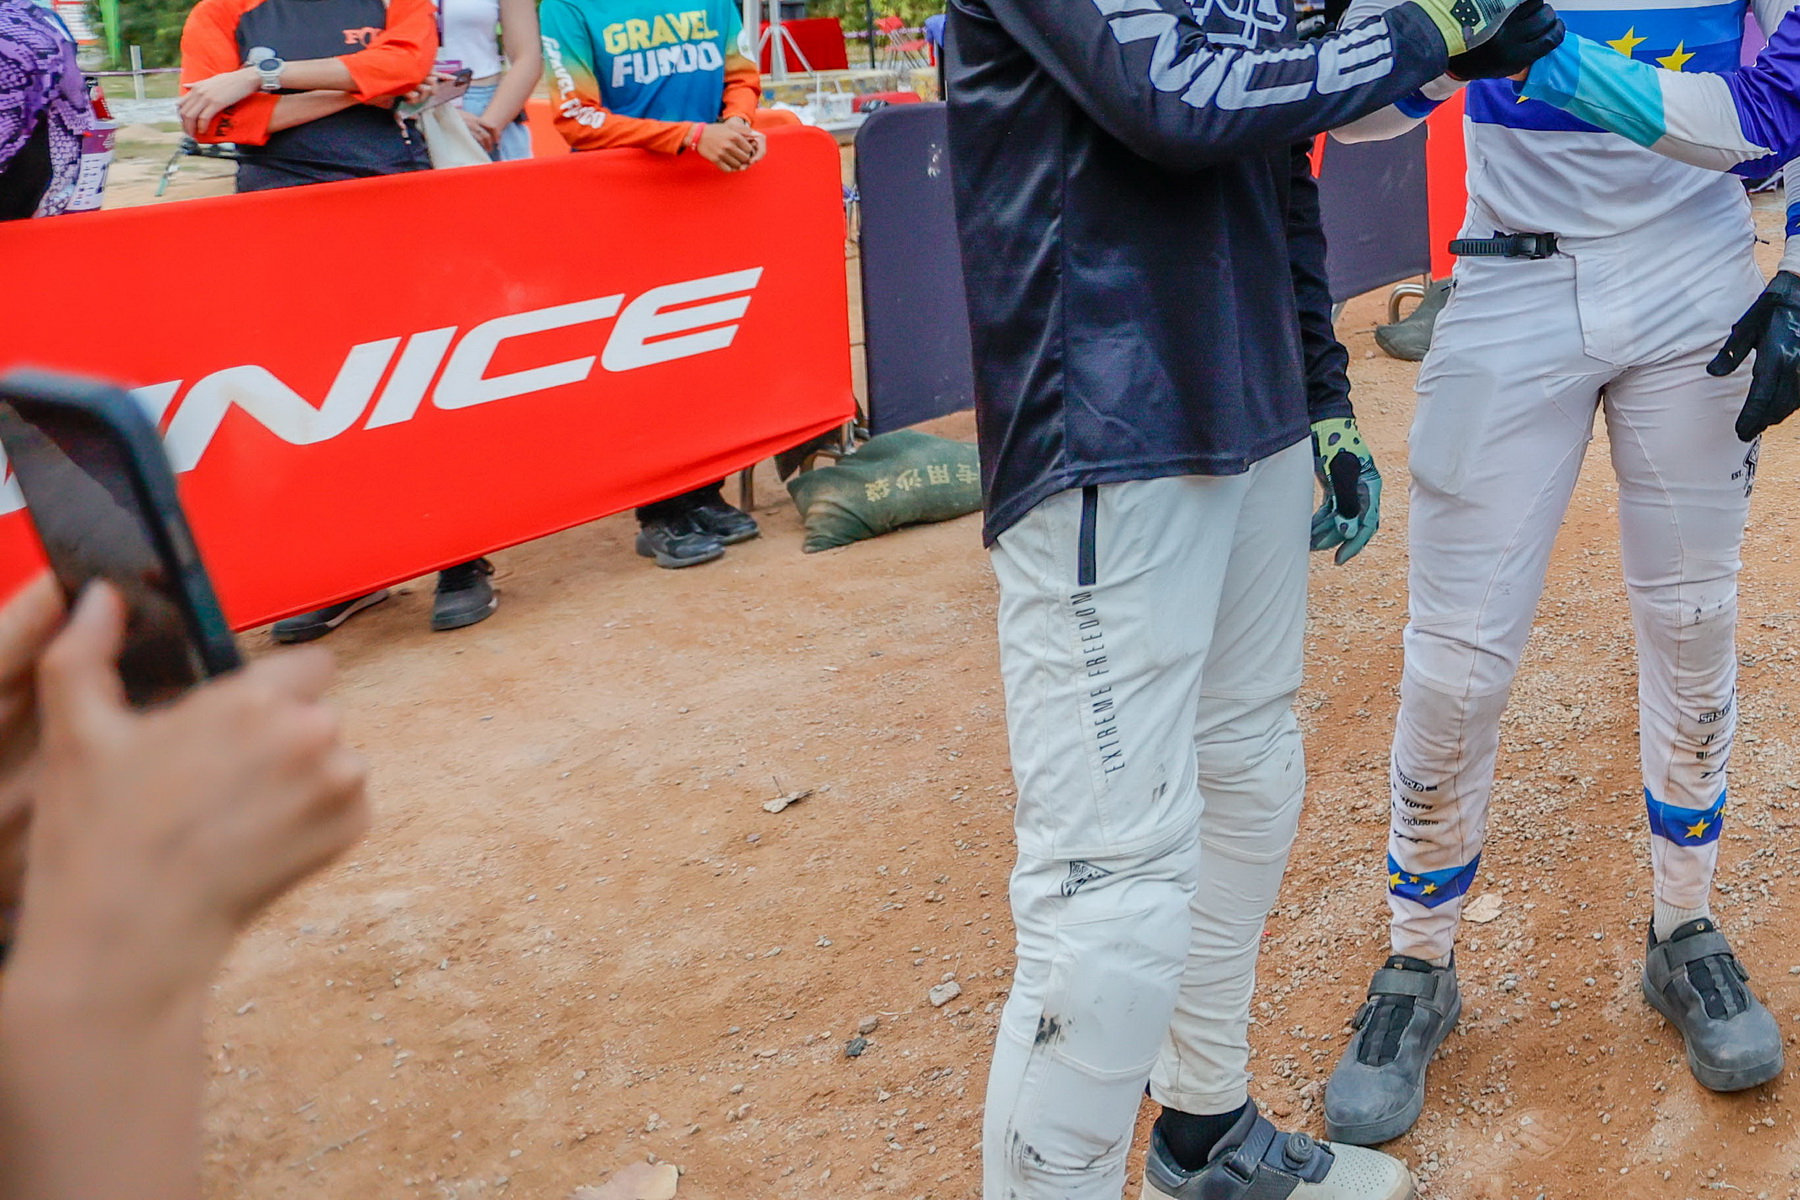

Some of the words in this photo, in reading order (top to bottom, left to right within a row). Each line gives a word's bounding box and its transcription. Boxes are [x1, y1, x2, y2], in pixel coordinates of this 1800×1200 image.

[602, 10, 719, 54] GRAVEL
[128, 266, 764, 477] NICE
[1071, 590, 1108, 678] FREEDOM
[1091, 685, 1127, 774] EXTREME
